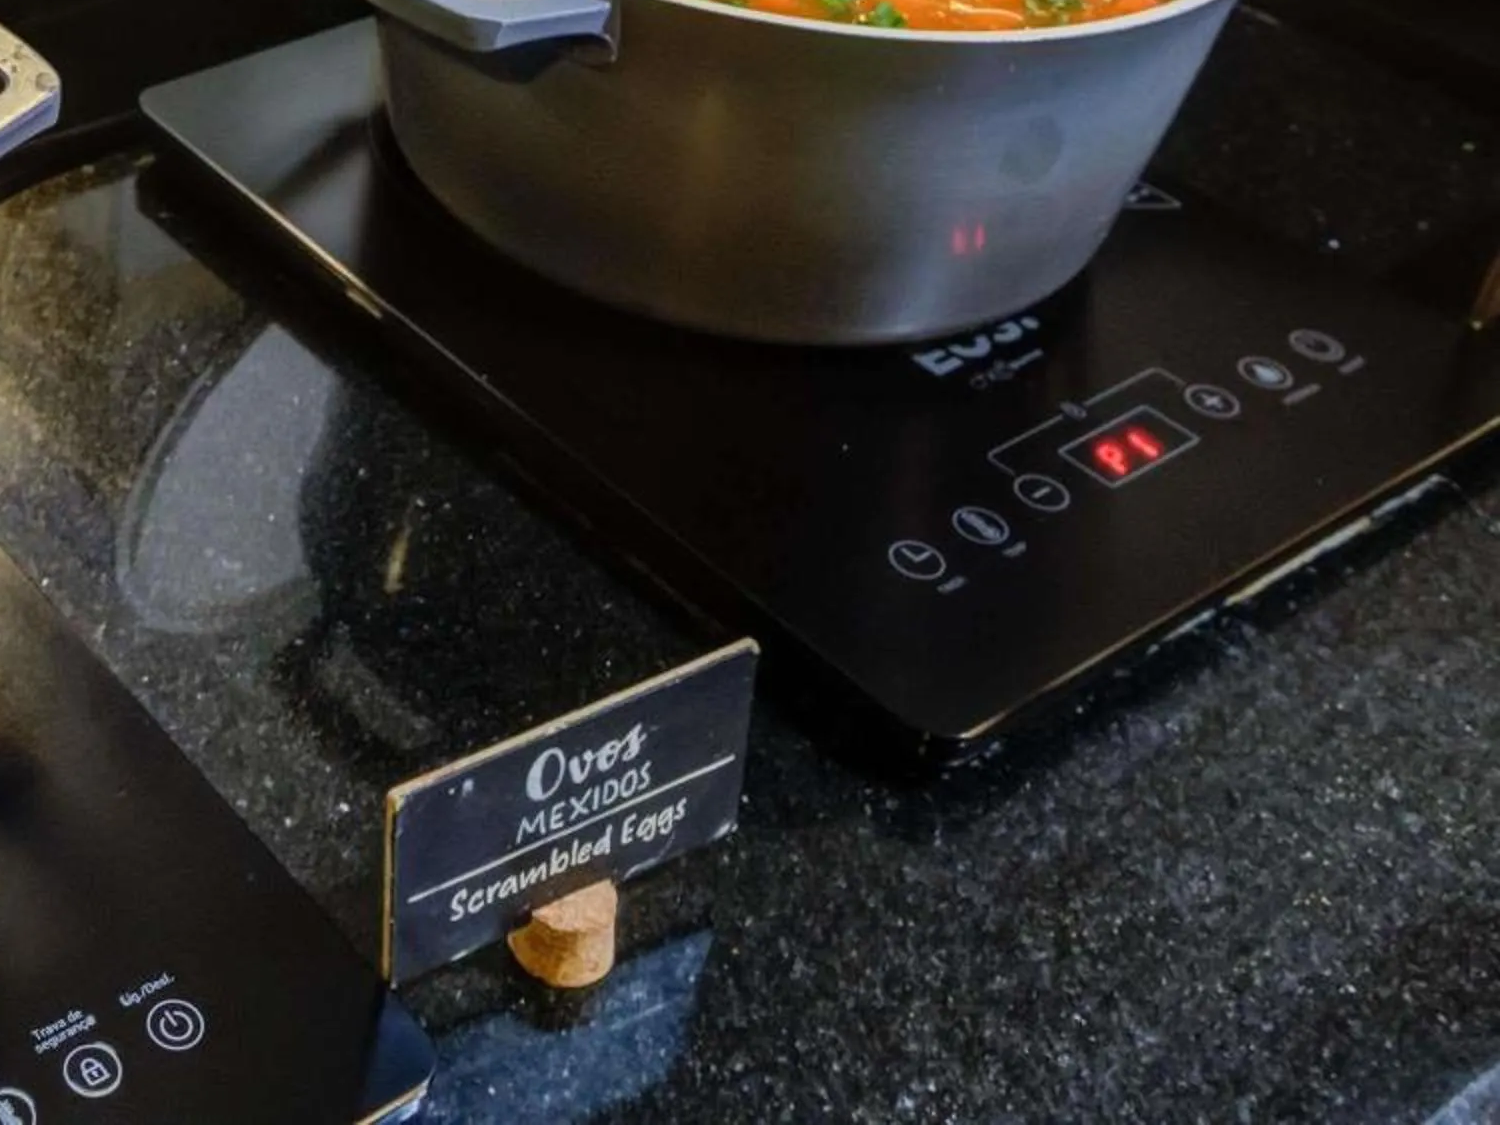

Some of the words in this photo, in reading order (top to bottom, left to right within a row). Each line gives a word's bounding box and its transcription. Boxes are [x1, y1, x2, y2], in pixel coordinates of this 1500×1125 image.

[515, 761, 652, 843] MEXIDOS
[526, 722, 650, 802] Ovos
[449, 825, 613, 923] Scrambled
[620, 796, 688, 845] Eggs
